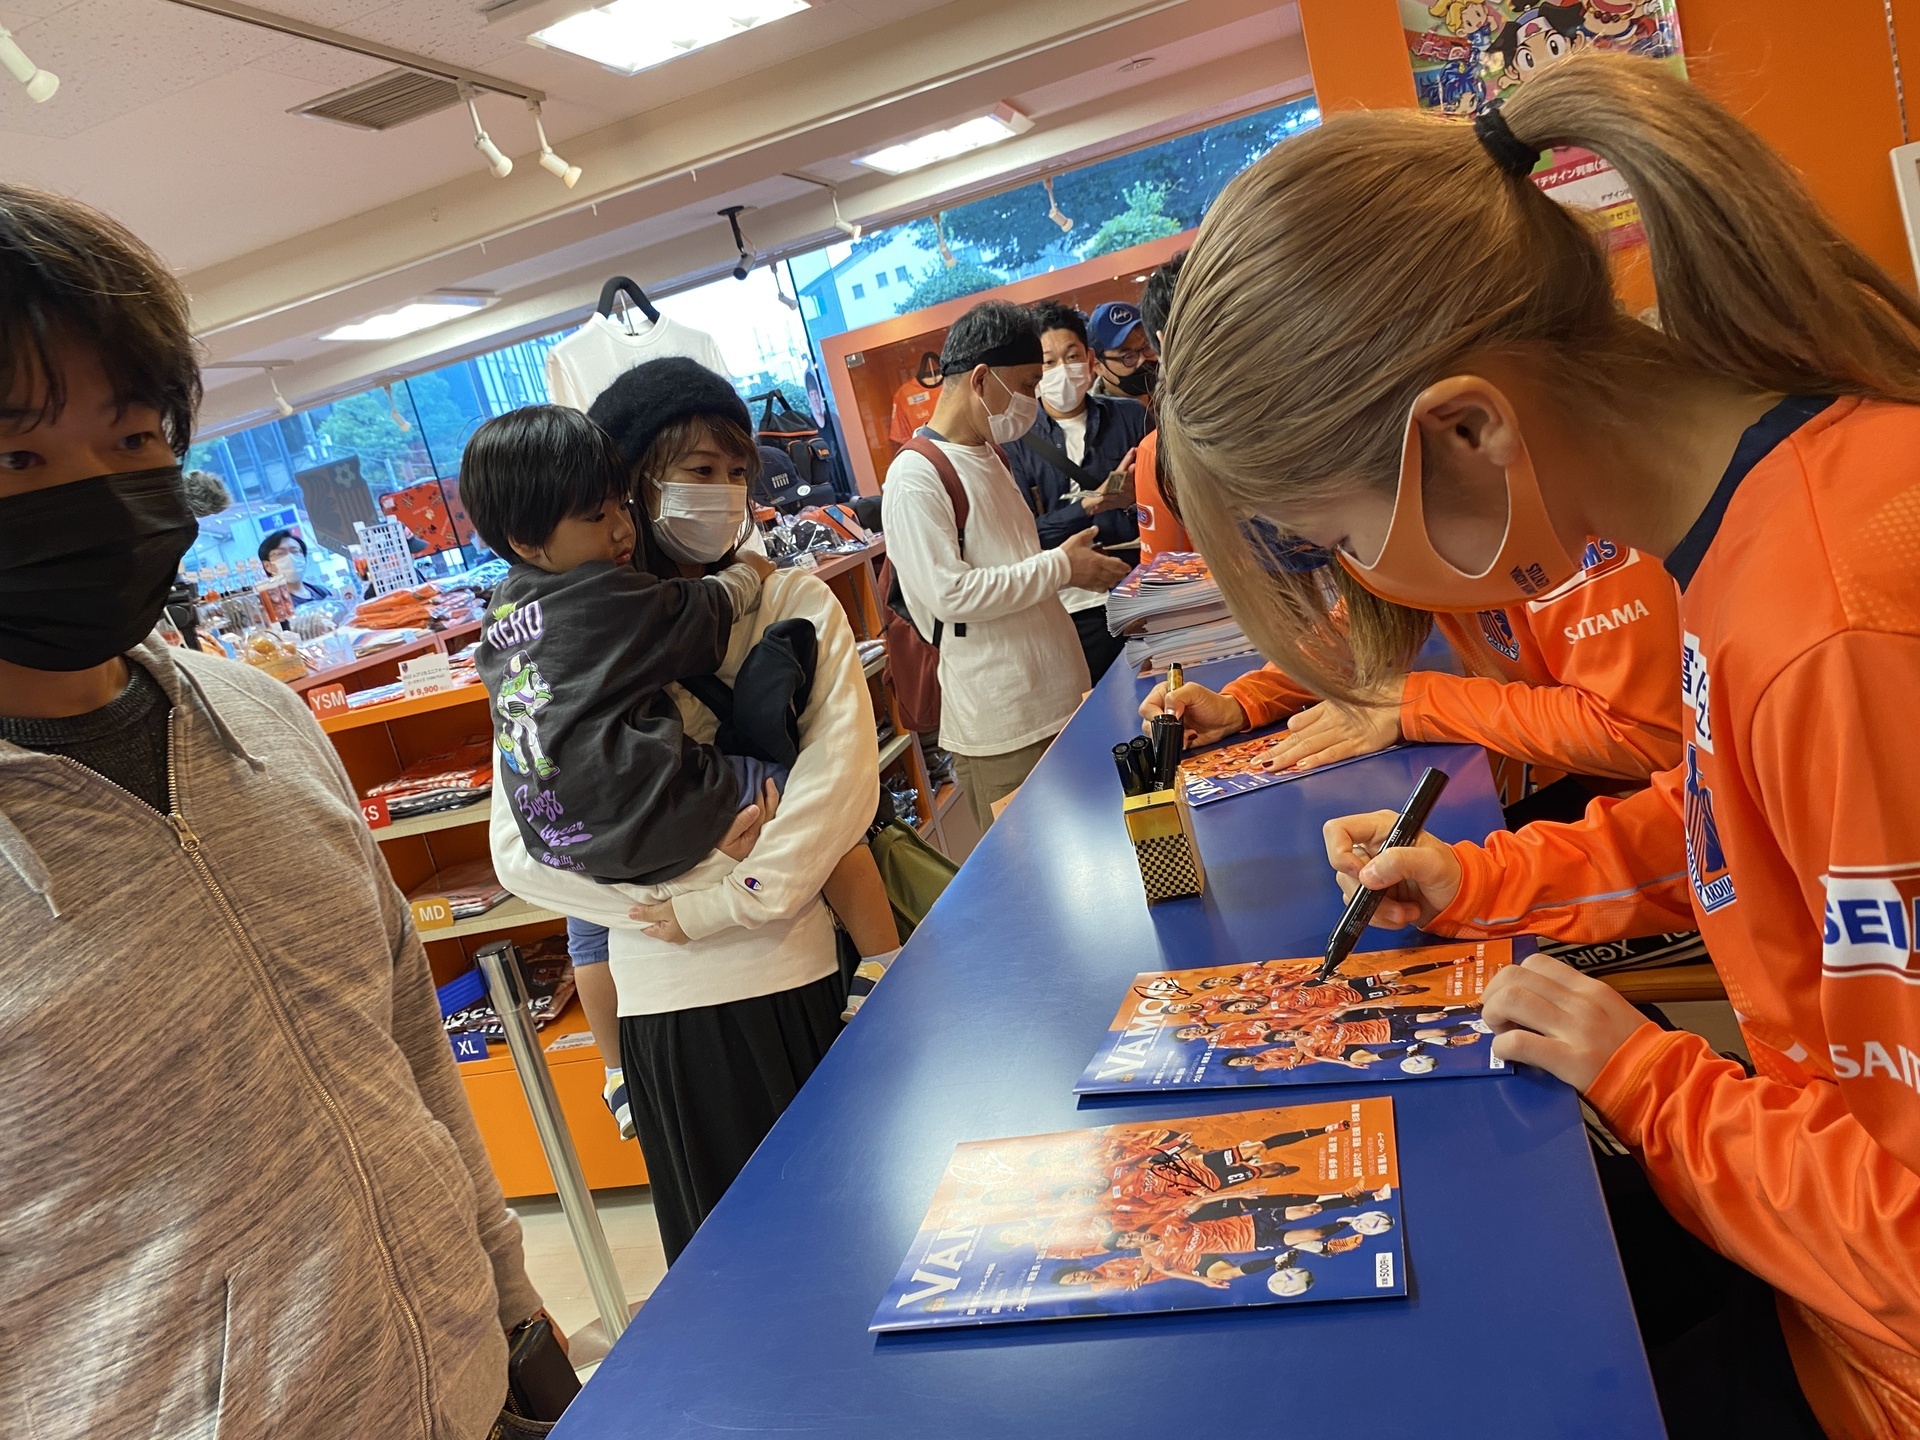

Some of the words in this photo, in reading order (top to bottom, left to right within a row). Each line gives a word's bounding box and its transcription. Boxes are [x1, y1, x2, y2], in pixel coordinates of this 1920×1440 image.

[487, 600, 543, 650] HERO
[311, 690, 346, 711] YSM
[418, 905, 446, 922] MD
[457, 1039, 479, 1056] XL
